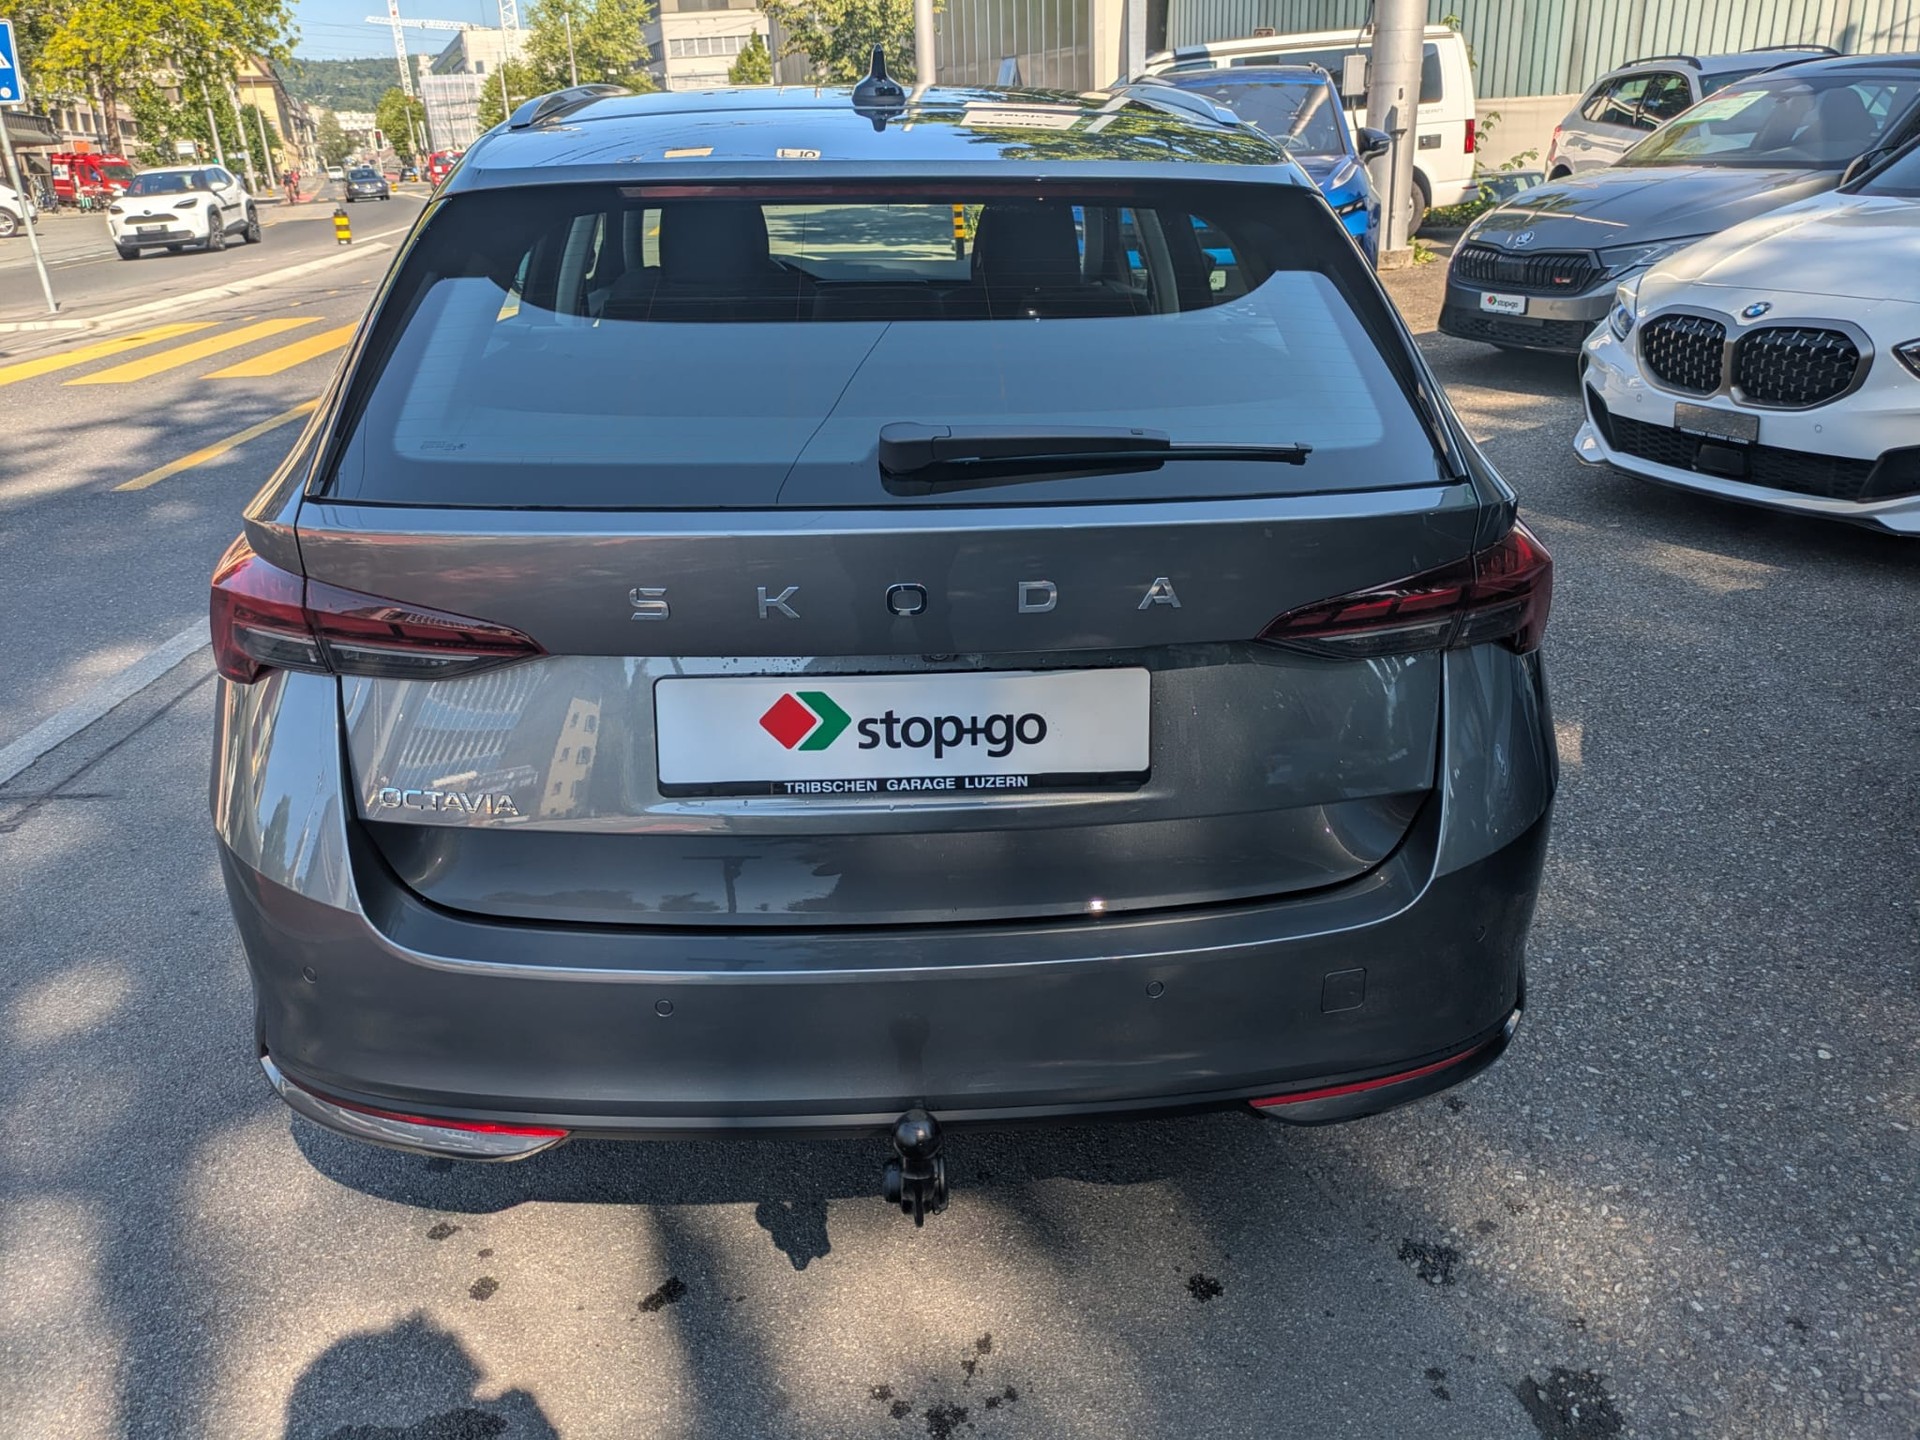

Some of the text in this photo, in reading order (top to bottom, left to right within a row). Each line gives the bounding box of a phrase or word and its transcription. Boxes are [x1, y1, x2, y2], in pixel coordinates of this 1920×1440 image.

[629, 576, 1182, 621] SKODA
[857, 709, 1047, 759] stop+go
[378, 787, 520, 816] OCTAVIA
[784, 775, 1029, 794] TRIBSCHEN GARAGE LUZERN
